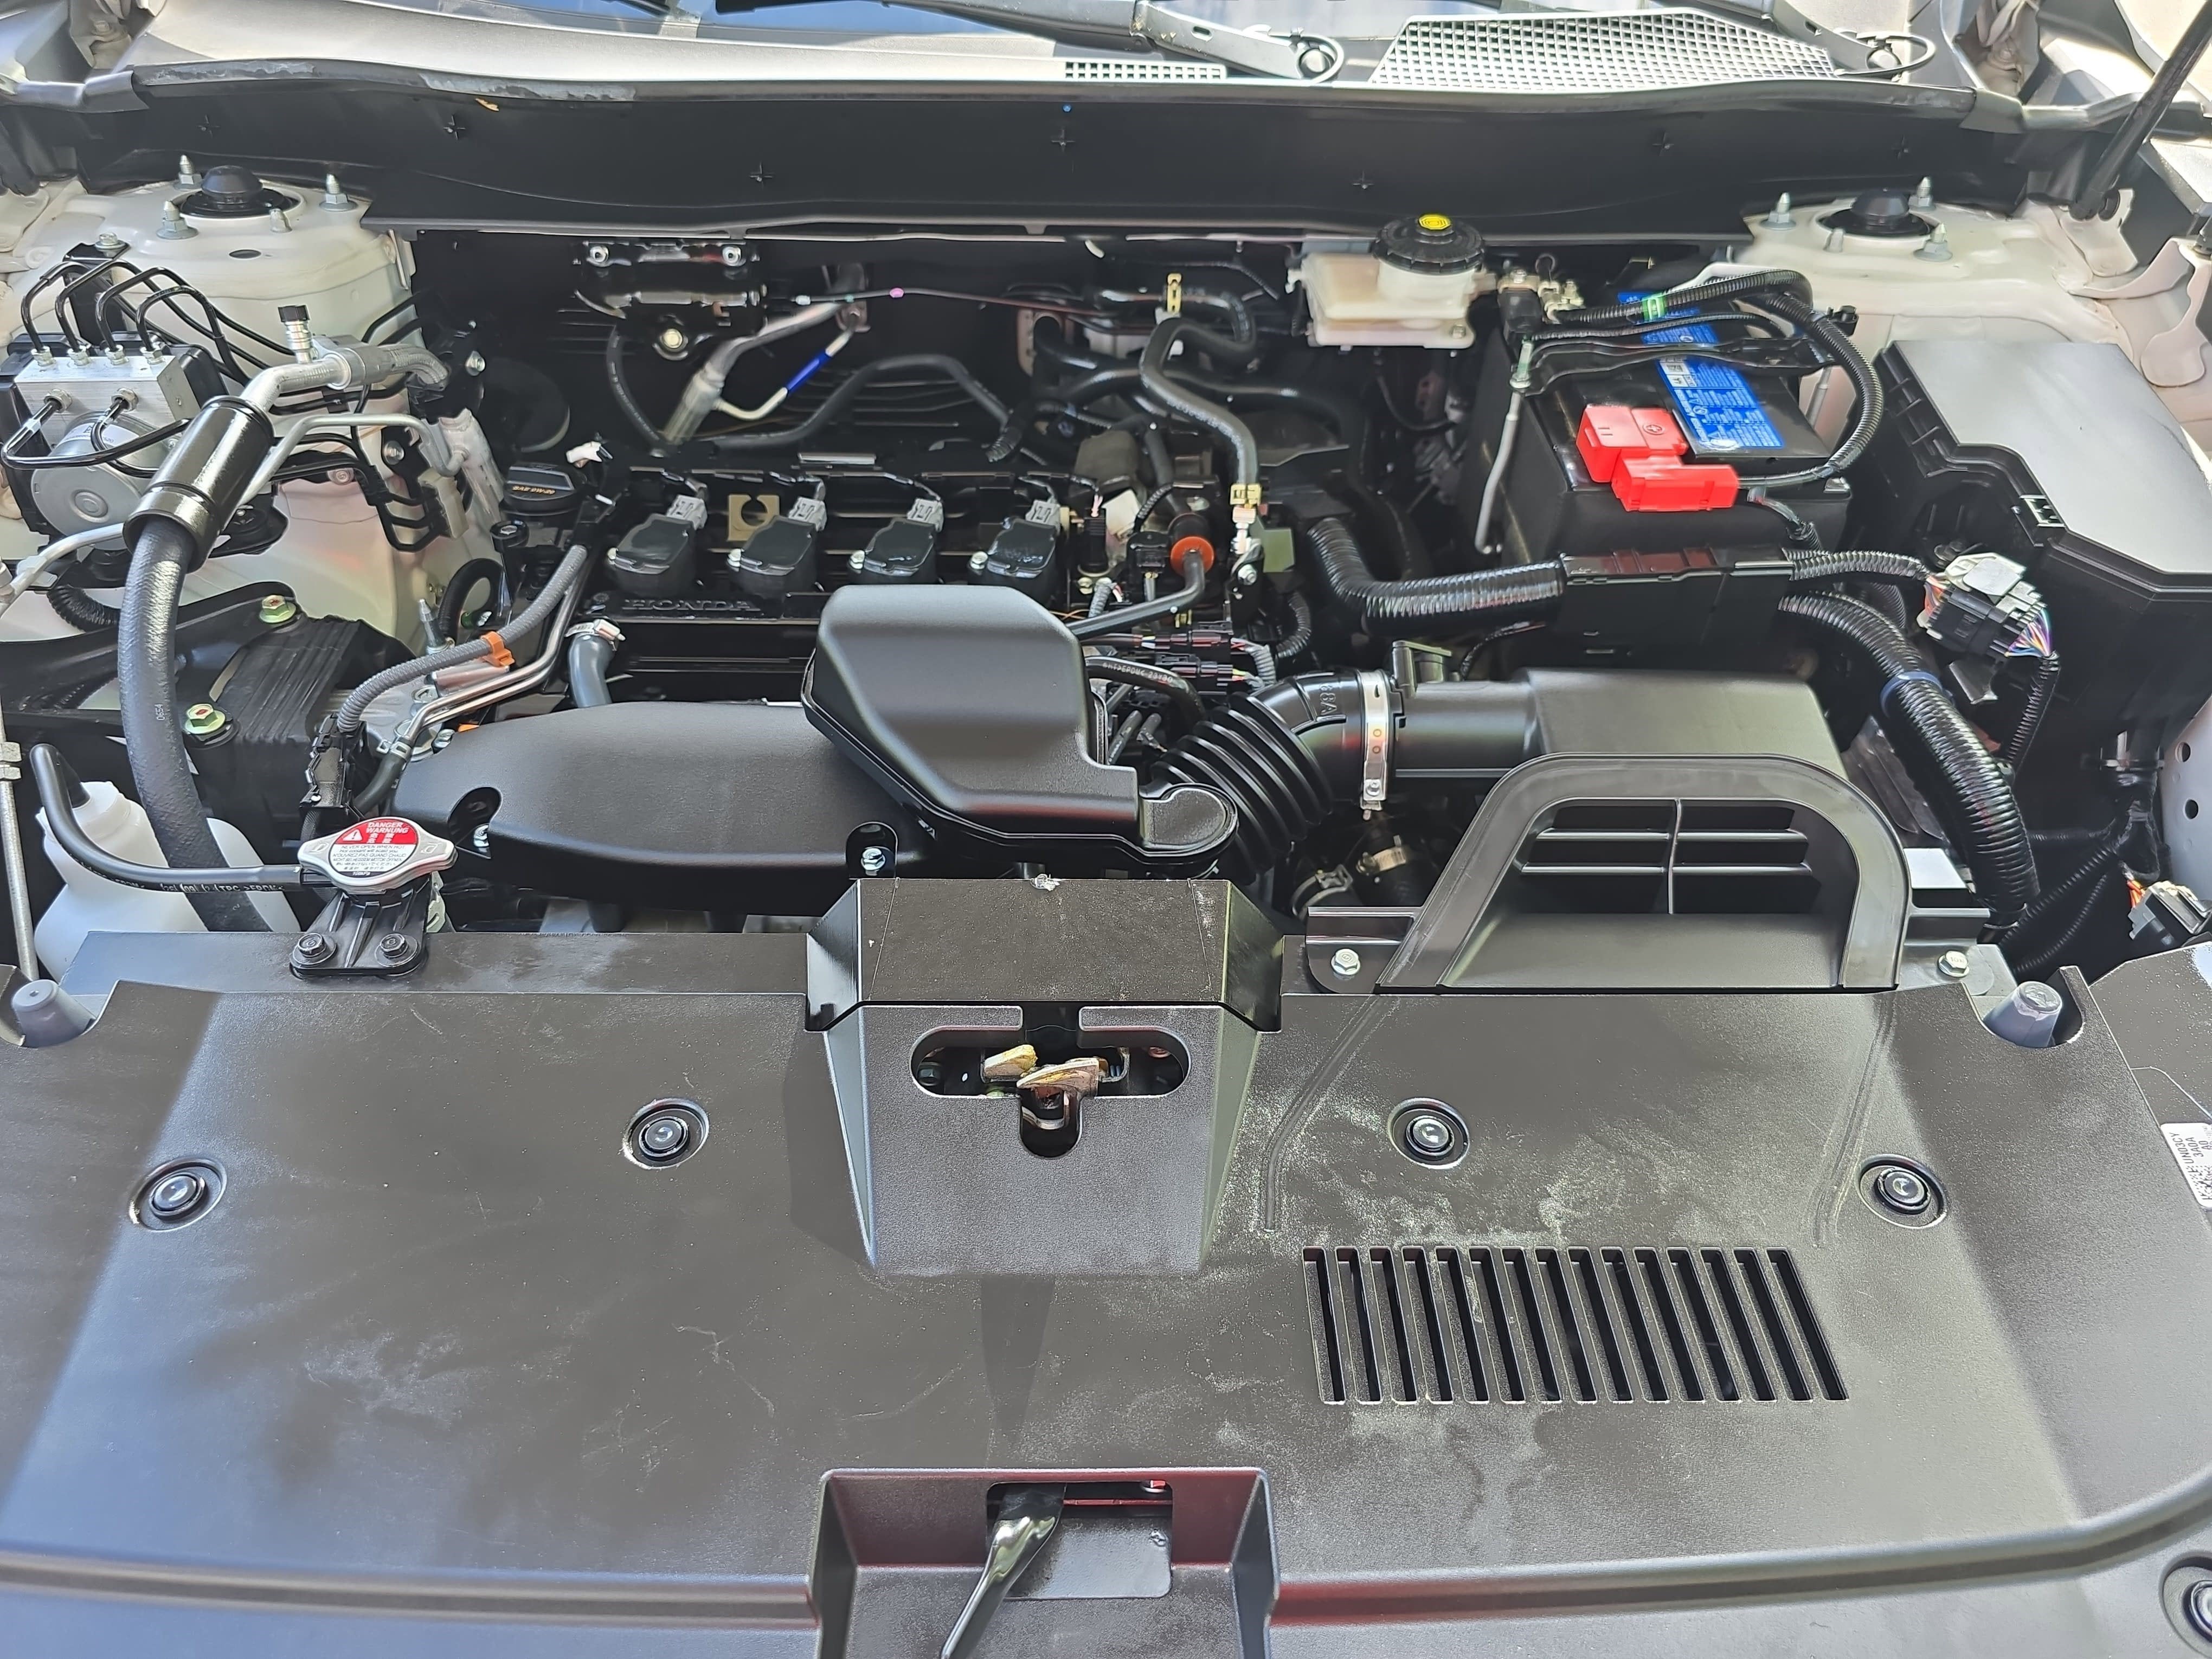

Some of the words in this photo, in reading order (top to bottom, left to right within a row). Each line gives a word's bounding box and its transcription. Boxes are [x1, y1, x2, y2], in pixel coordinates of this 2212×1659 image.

[622, 599, 761, 611] HONDA
[2169, 1132, 2194, 1163] UN03CY
[2185, 1137, 2204, 1158] 3A0A
